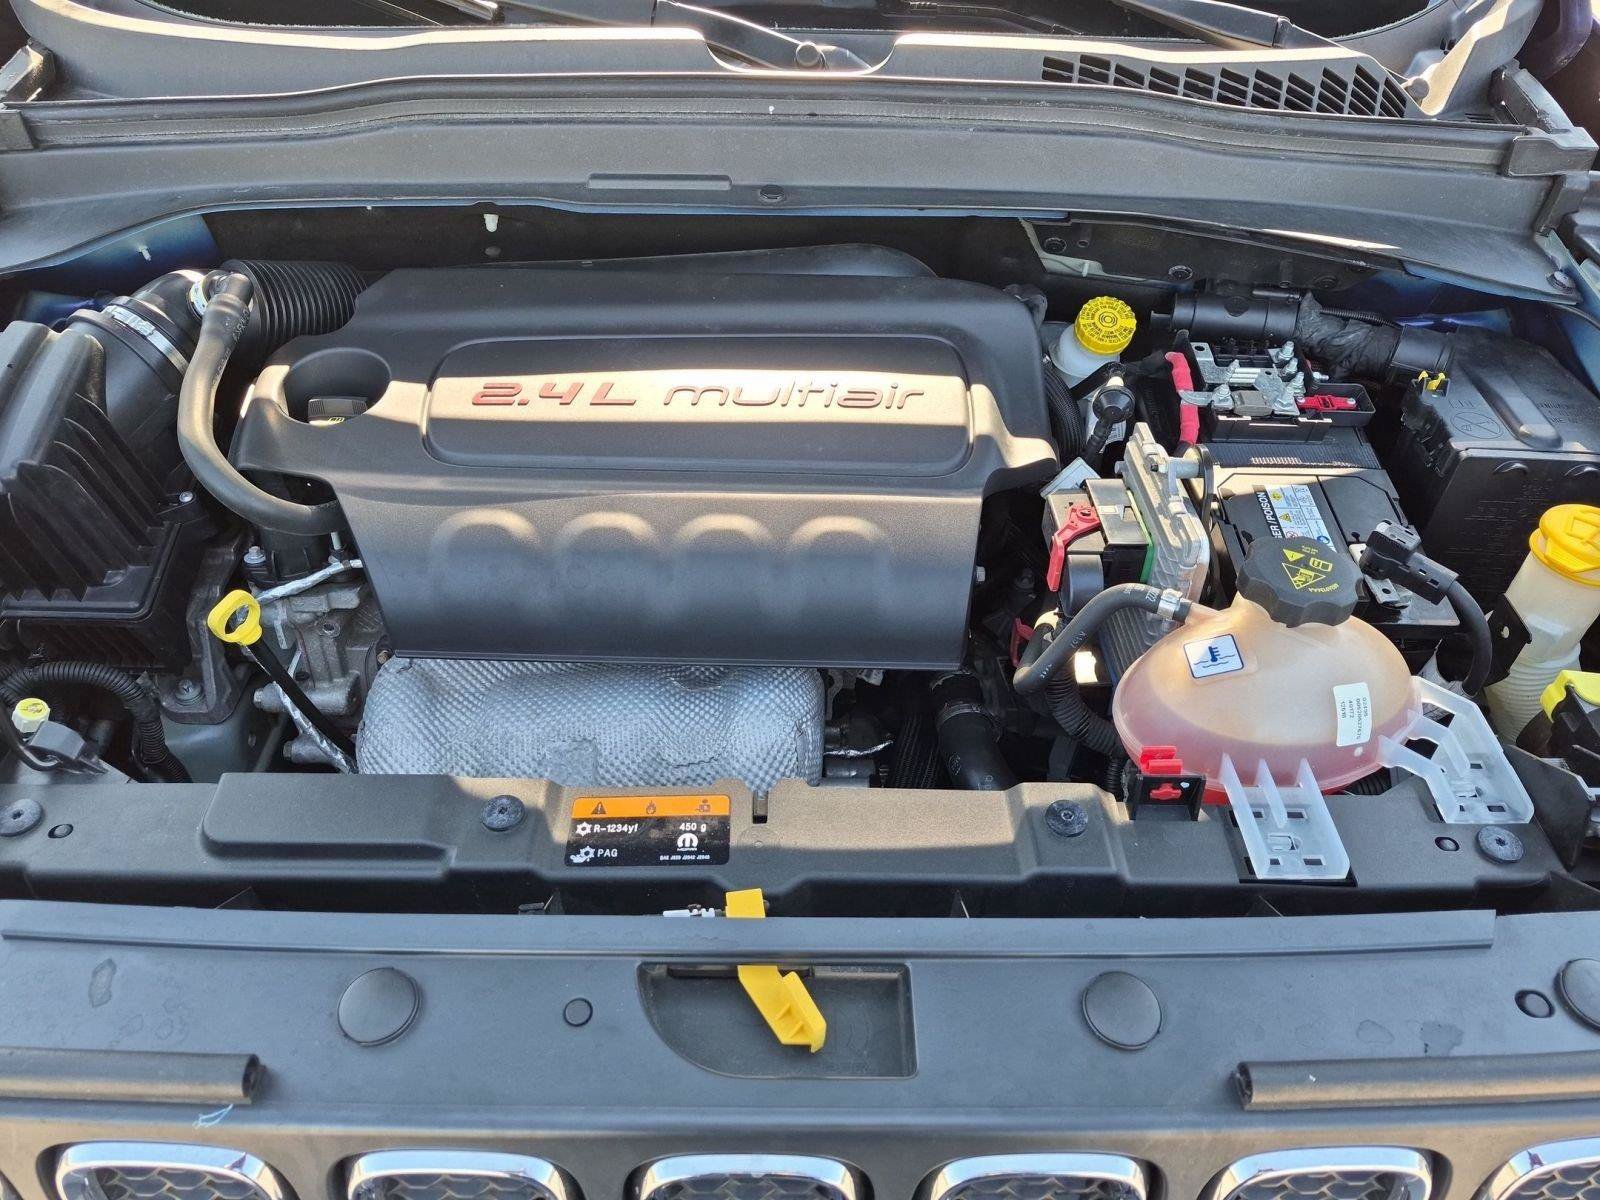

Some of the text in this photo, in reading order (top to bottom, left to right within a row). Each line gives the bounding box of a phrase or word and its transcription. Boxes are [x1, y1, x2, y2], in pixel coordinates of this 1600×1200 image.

[471, 376, 926, 410] 2.4L multiair
[593, 823, 639, 833] R-1234yf
[679, 822, 707, 833] 450 g
[596, 848, 618, 858] PAG
